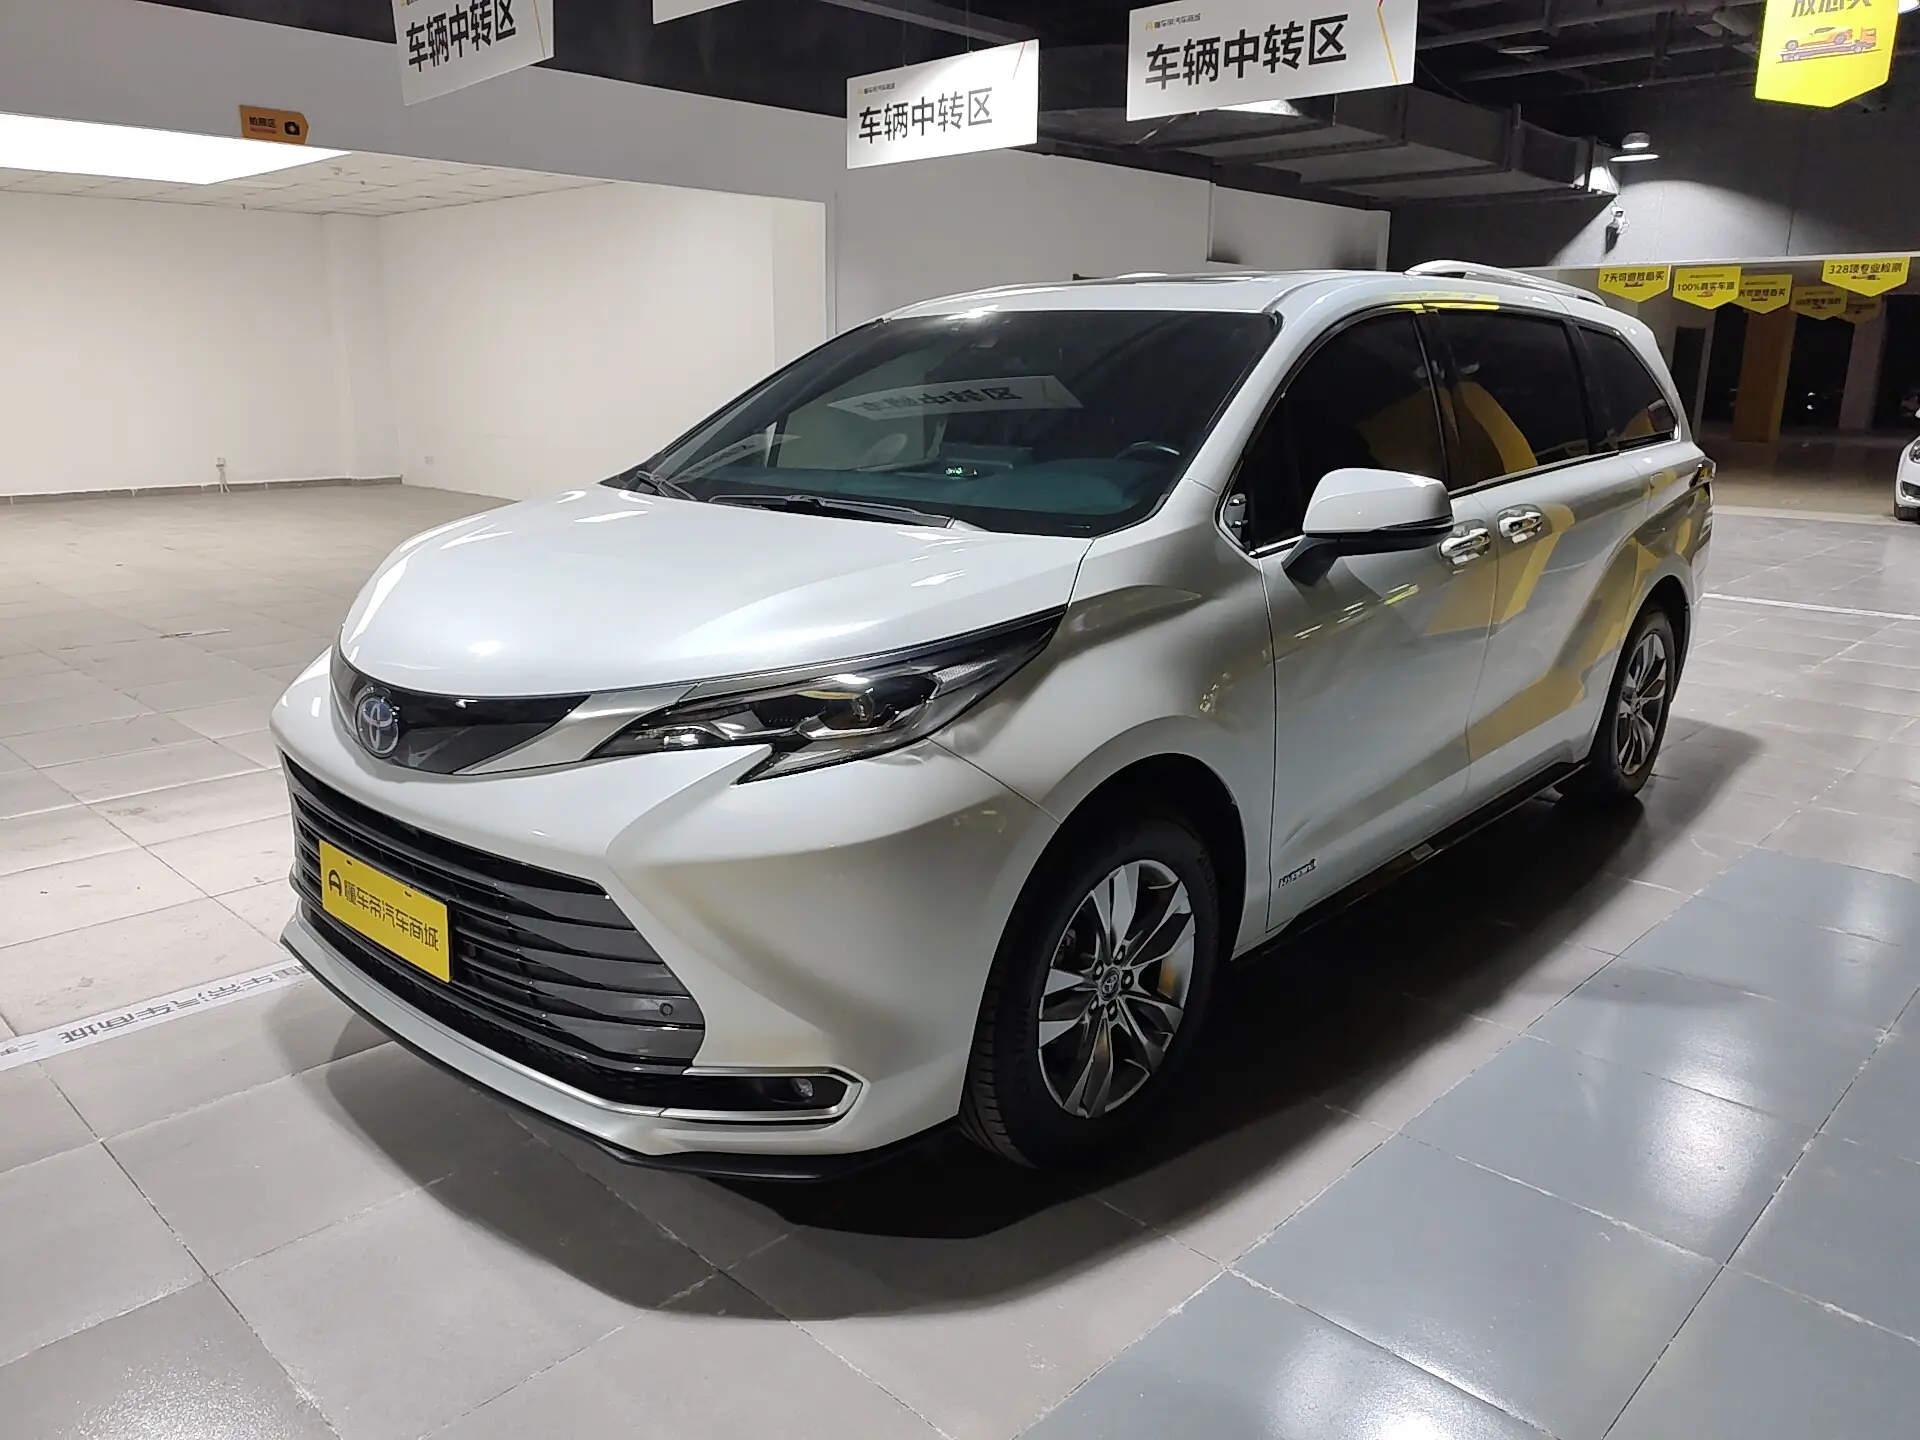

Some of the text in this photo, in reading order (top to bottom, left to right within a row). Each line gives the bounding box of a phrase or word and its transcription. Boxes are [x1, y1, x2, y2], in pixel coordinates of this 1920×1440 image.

[406, 0, 516, 72] 车辆中转区
[1145, 14, 1348, 90] 车辆中转区
[859, 87, 992, 144] 车辆中转区
[1828, 262, 1903, 275] 328项专业检测
[344, 880, 440, 951] 懂车帝汽车商城
